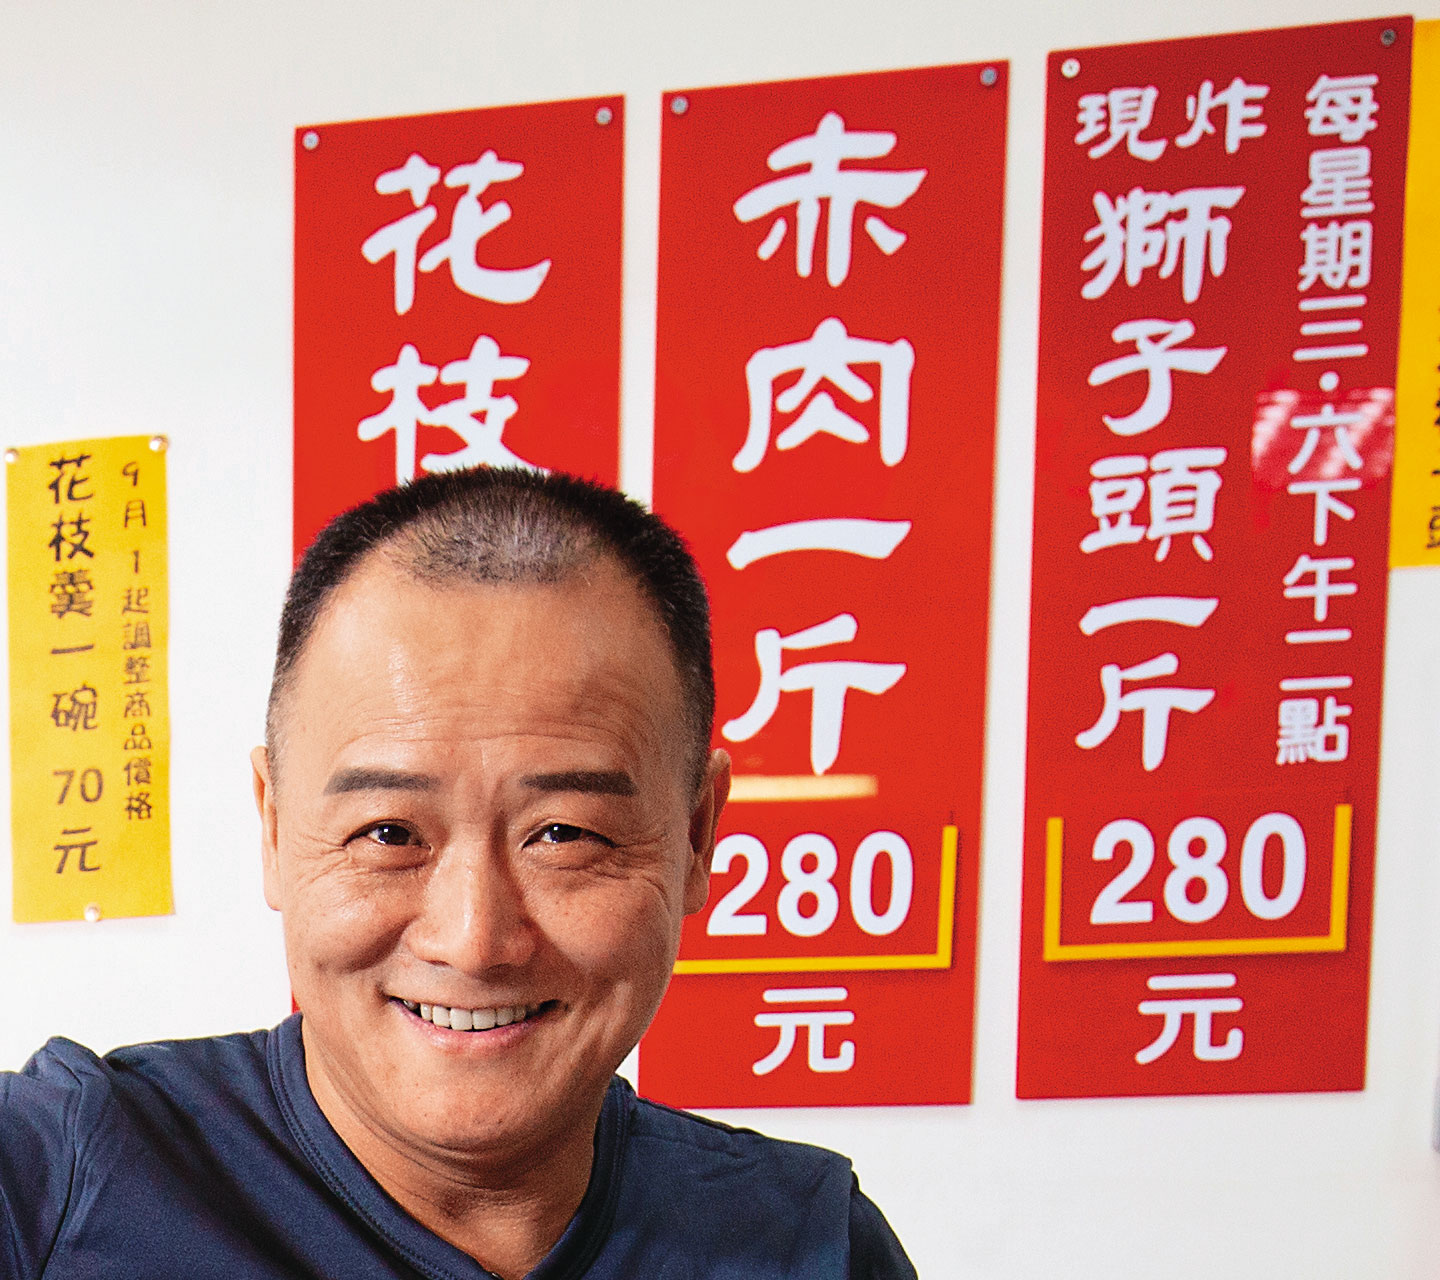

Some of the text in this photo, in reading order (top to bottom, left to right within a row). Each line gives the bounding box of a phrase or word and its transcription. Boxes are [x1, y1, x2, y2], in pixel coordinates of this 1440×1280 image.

[1073, 76, 1270, 162] 現炸
[357, 150, 552, 485] 花枝
[706, 112, 928, 1076] 赤肉一斤 280 元
[1075, 186, 1307, 1065] 獅子頭一斤 280 元
[53, 768, 104, 806] 70
[55, 827, 101, 874] 元
